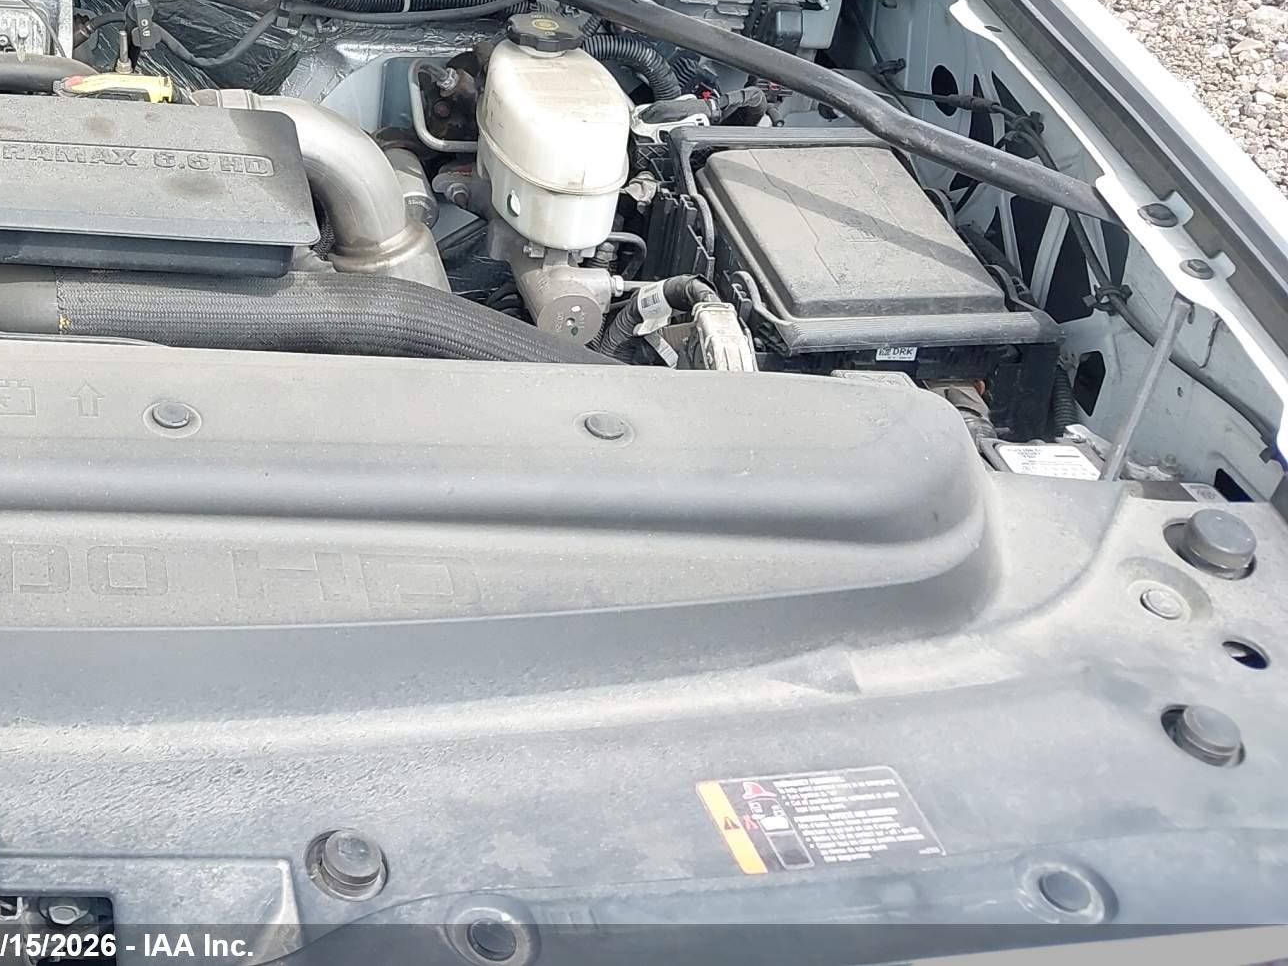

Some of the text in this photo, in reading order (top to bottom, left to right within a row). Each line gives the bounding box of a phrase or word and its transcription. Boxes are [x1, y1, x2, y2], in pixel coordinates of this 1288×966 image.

[152, 150, 211, 171] 6.6
[219, 154, 269, 176] HD
[893, 347, 914, 356] DRK
[230, 549, 483, 606] HD
